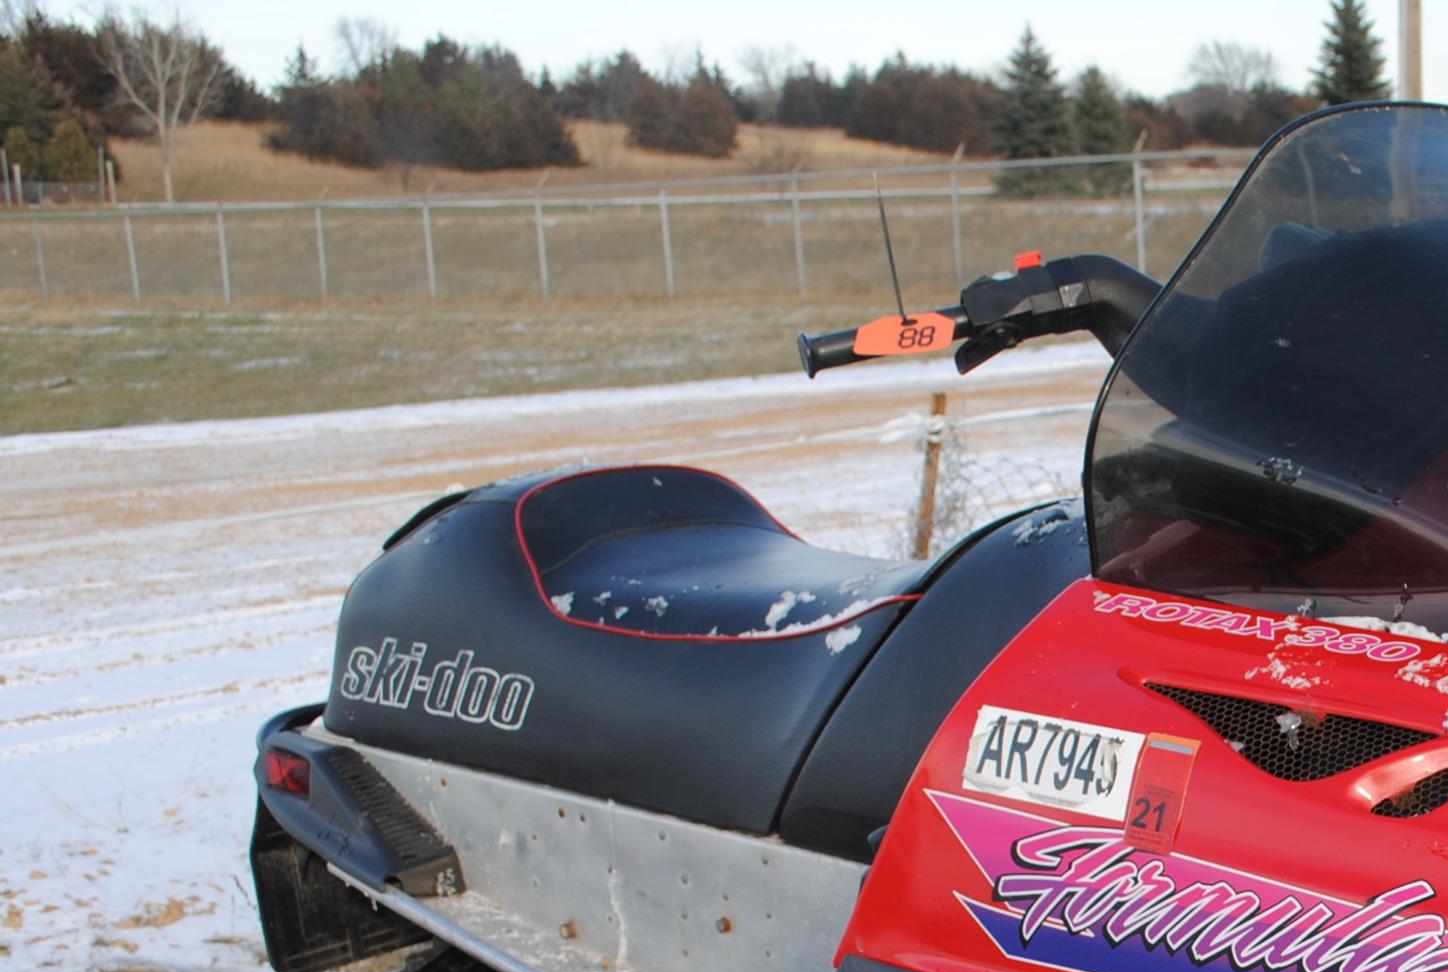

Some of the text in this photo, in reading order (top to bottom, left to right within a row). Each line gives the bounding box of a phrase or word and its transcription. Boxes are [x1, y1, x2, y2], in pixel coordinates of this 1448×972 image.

[897, 325, 936, 349] 88
[1094, 592, 1422, 662] ROTAX 380
[340, 636, 535, 731] ski-doo
[1131, 797, 1168, 833] 21
